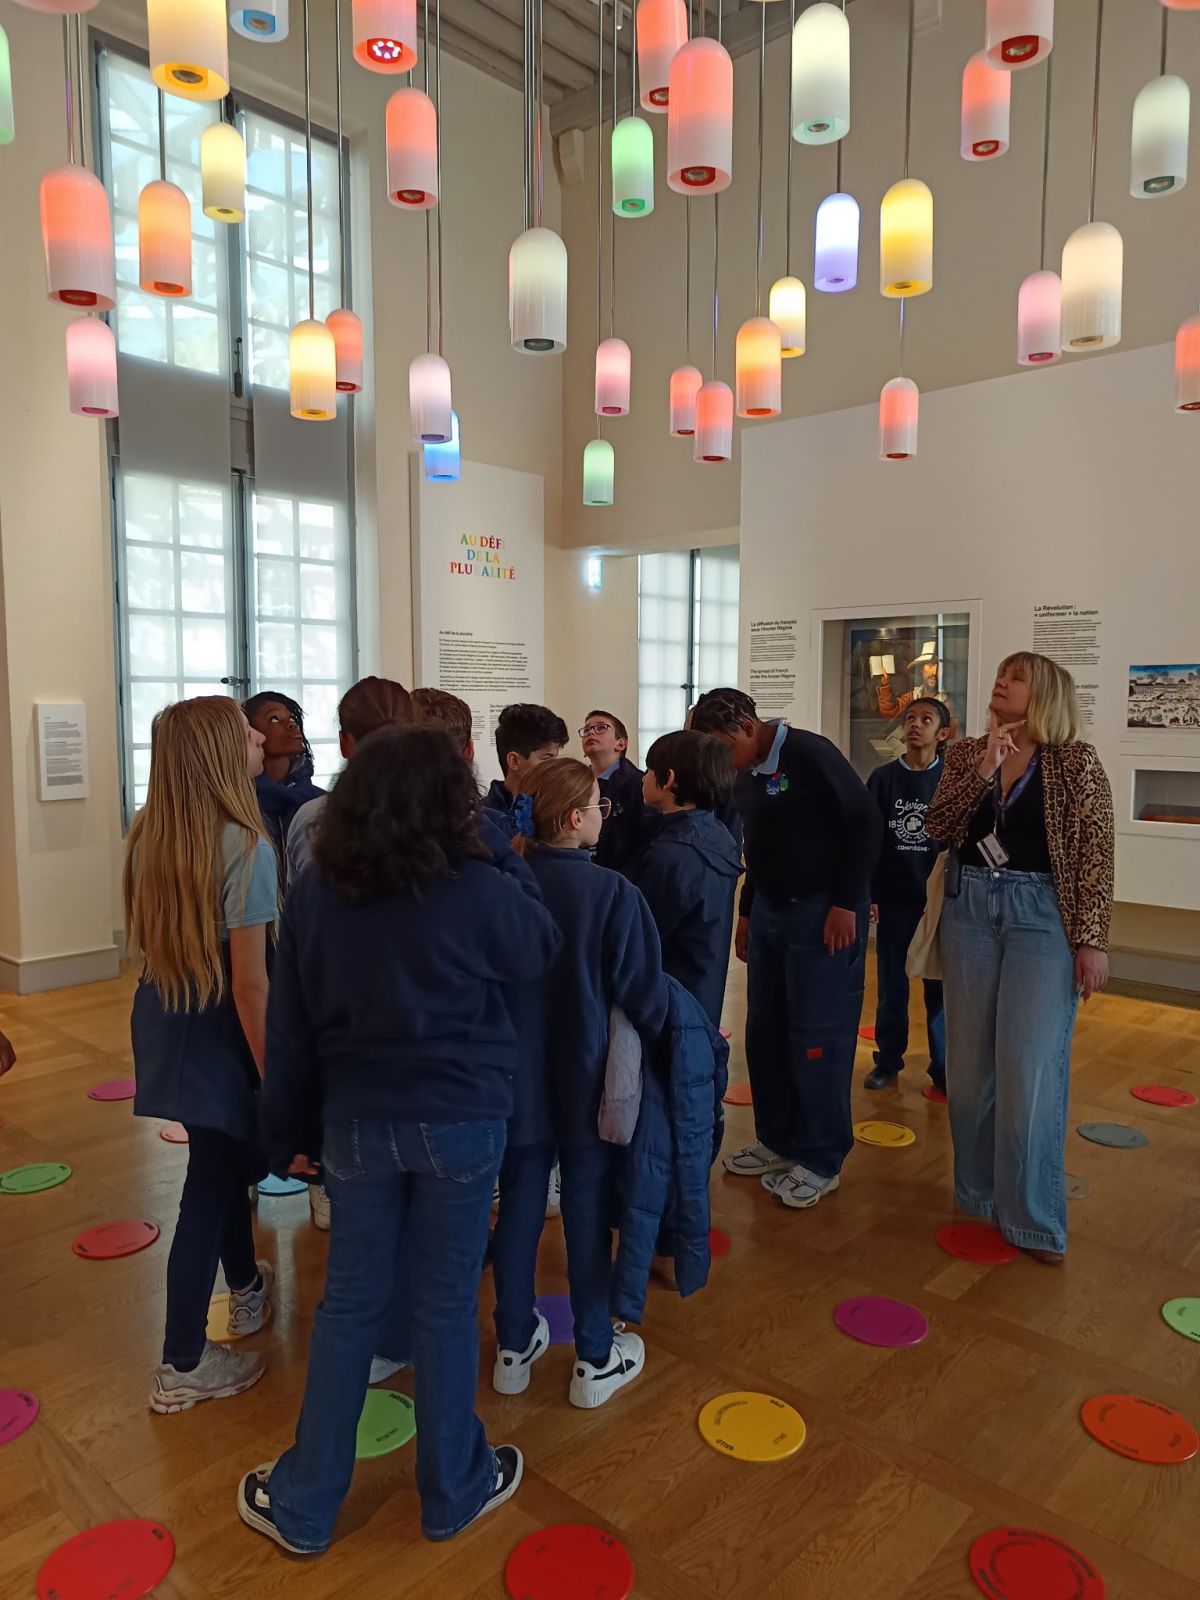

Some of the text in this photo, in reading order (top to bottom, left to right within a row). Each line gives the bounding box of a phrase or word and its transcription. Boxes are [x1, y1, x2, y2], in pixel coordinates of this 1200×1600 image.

[461, 533, 476, 546] AU
[467, 549, 500, 564] DE LA
